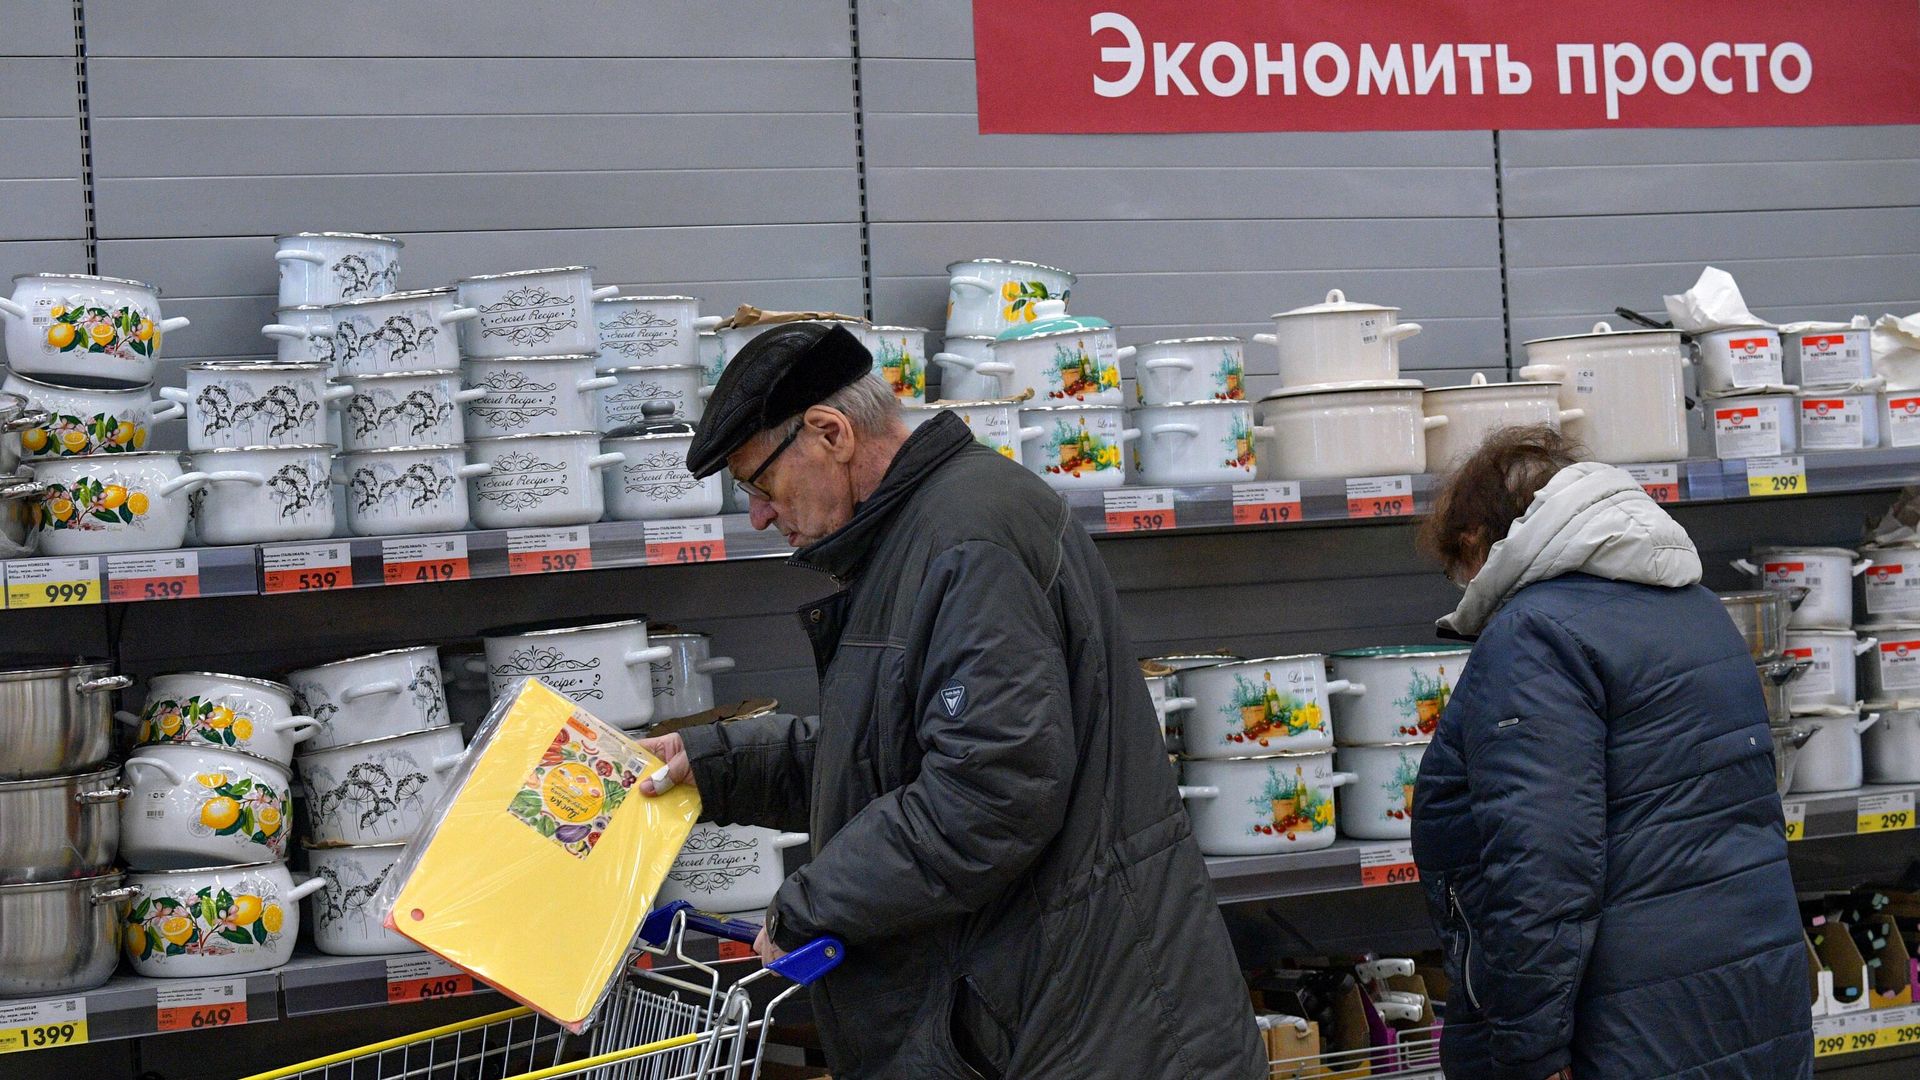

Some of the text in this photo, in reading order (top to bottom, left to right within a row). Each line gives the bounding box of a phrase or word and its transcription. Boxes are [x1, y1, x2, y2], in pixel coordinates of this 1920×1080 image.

[1090, 12, 1812, 120] Экономить просто
[494, 309, 560, 325] Secret Recipe
[610, 328, 664, 339] Secret Recipe
[505, 394, 537, 409] Recipe
[616, 402, 641, 411] Secret
[486, 475, 549, 489] Secret Recipe
[636, 471, 691, 482] Secret Recipe
[1771, 475, 1798, 491] 299
[1645, 486, 1668, 502] 49
[1259, 508, 1289, 525] 419
[1372, 500, 1402, 517] 349
[1132, 513, 1163, 531] 539
[541, 553, 577, 573] 539
[676, 545, 712, 564] 419
[415, 563, 454, 583] 419
[299, 572, 338, 592] 539
[45, 583, 87, 603] 999
[144, 581, 184, 601] 539
[540, 675, 576, 690] Recipe
[1881, 812, 1907, 829] 299
[672, 853, 740, 869] Secret Recipe
[1386, 866, 1416, 883] 649
[420, 979, 457, 1000] 649
[192, 1008, 231, 1028] 649
[20, 1024, 75, 1047] 1399
[1852, 1033, 1876, 1049] 299
[1897, 1026, 1920, 1042] 299
[1818, 1036, 1844, 1053] 299
